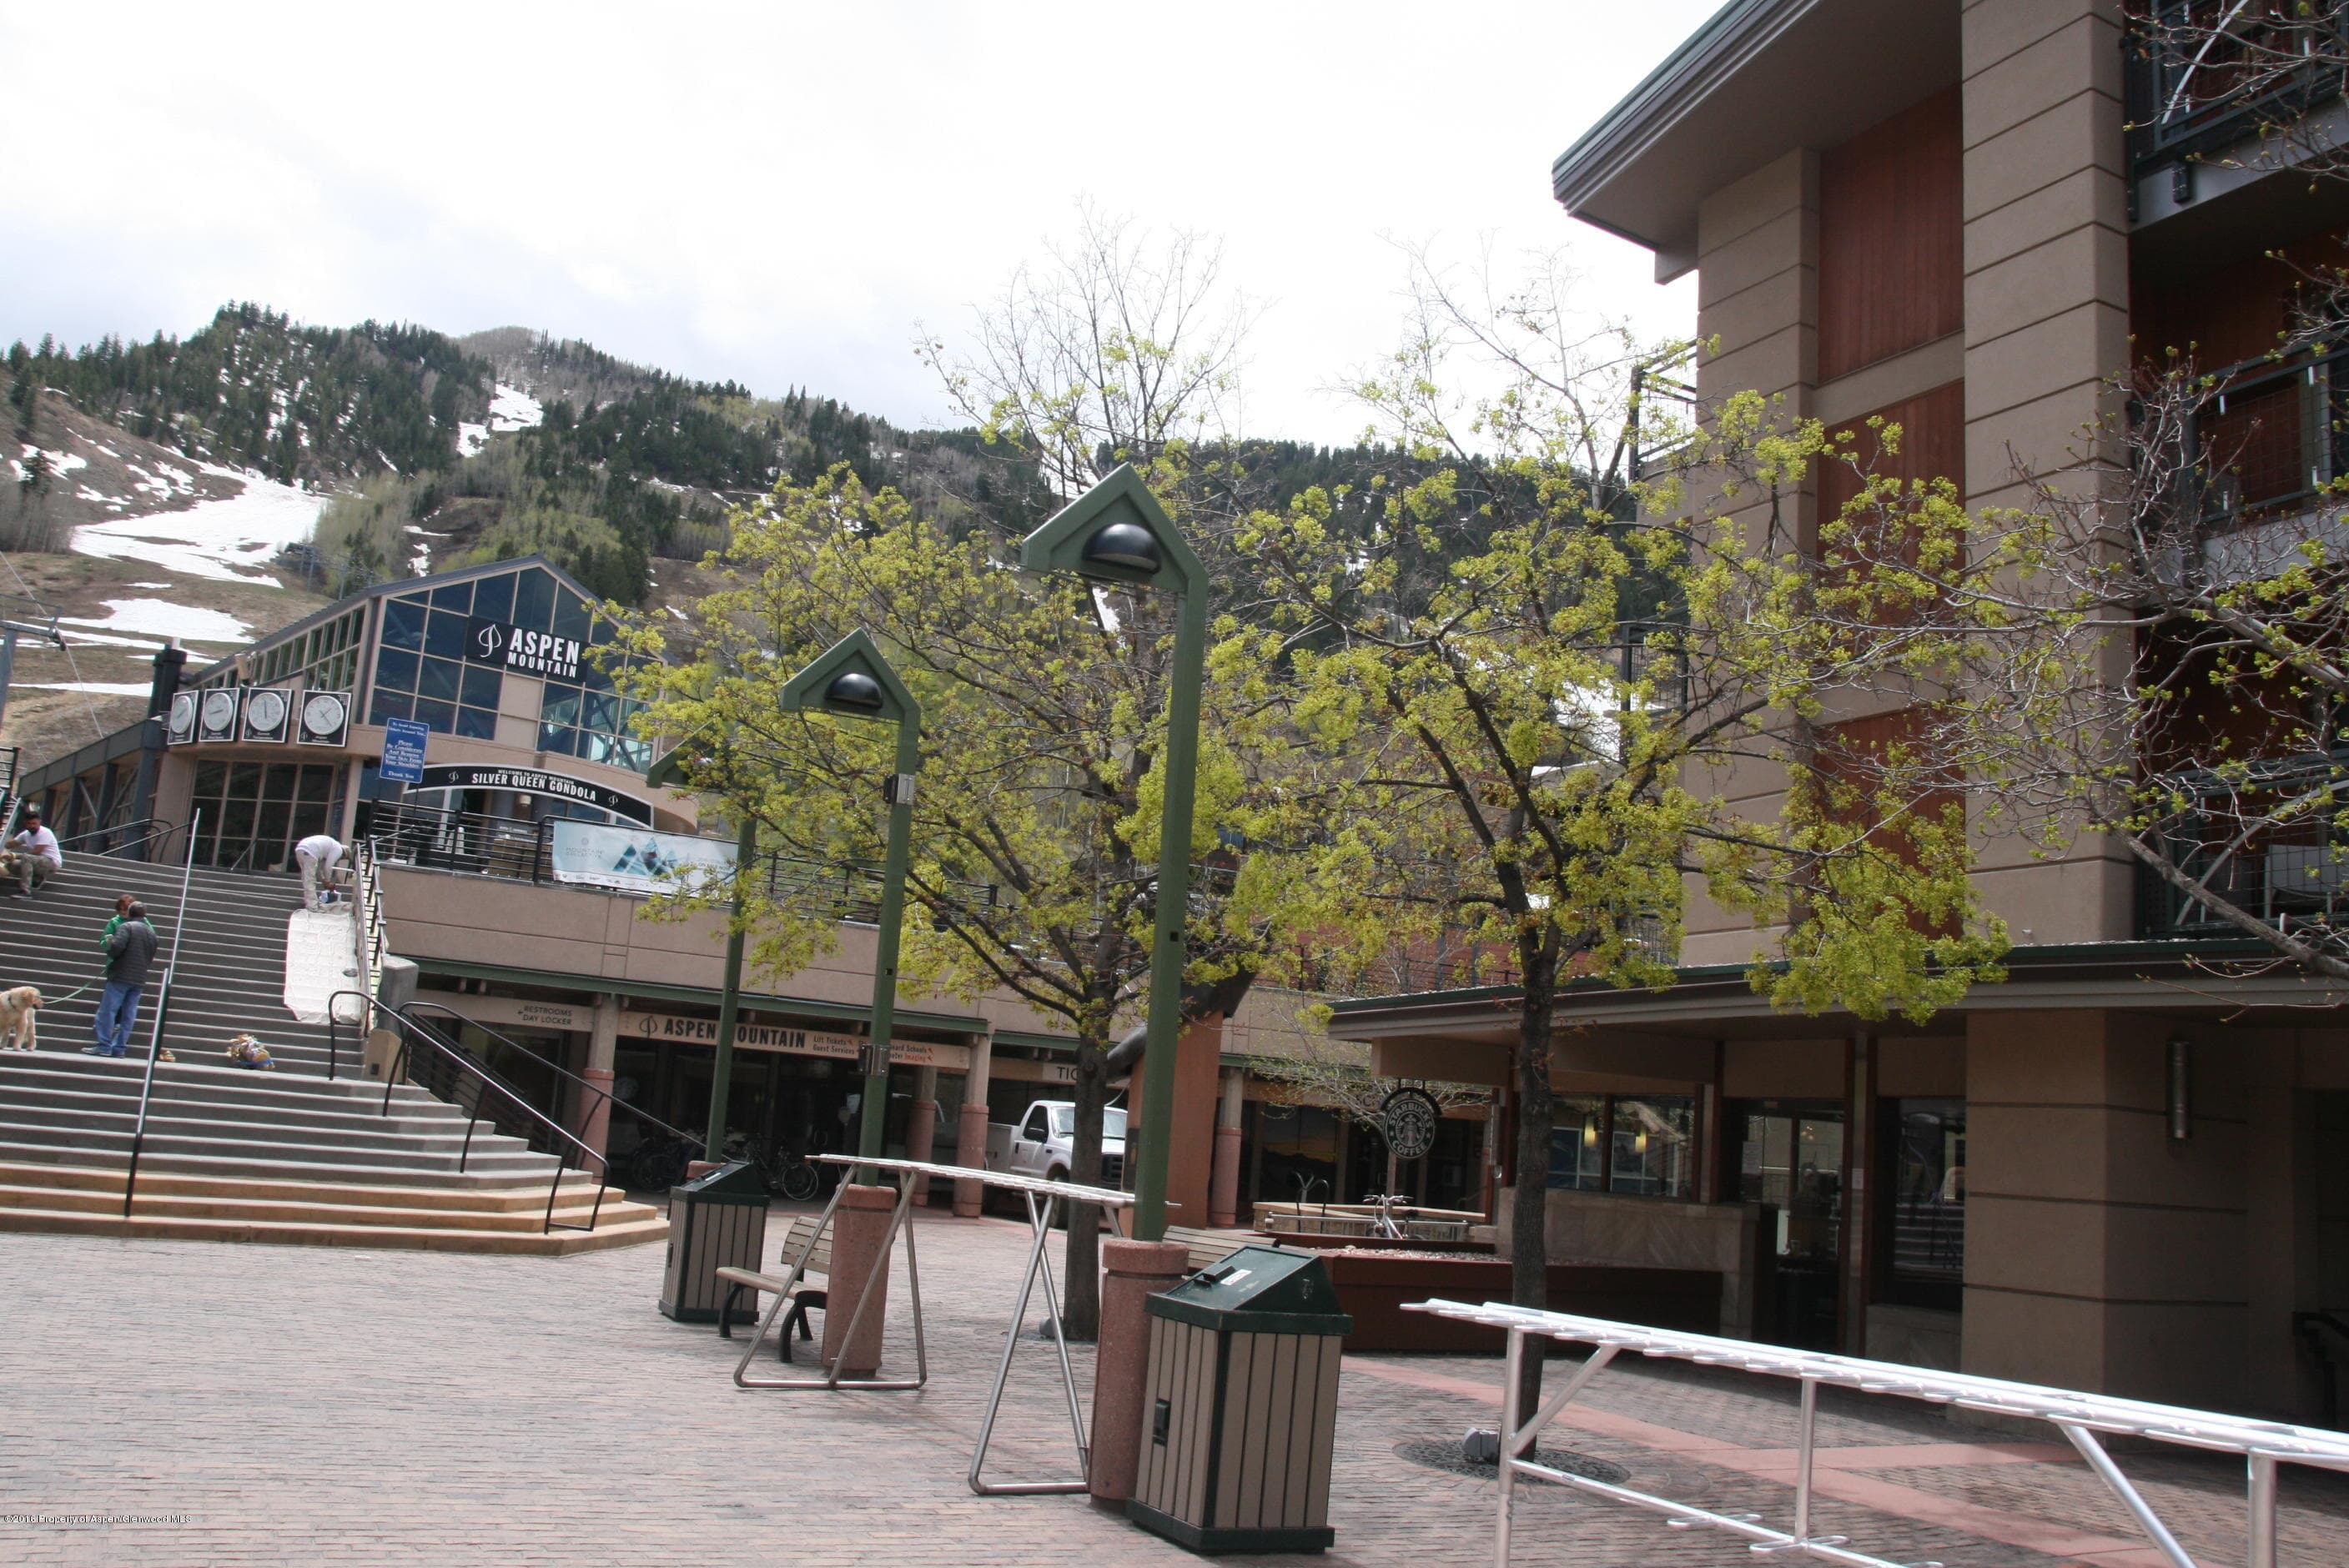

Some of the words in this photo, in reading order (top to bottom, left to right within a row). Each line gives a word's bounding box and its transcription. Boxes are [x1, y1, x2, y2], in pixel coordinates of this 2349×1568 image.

[510, 628, 580, 665] ASPEN
[507, 651, 577, 678] MOUNTAIN
[471, 773, 508, 785] SILVER
[511, 775, 546, 789] QUEEN
[549, 780, 596, 802] GONDOLA
[549, 776, 575, 785] MOUNTAIN
[524, 1006, 573, 1017] RESTROOMS
[541, 1016, 572, 1025] LOCKER
[664, 1018, 716, 1039] ASPEN
[737, 1026, 805, 1048] OUNTAIN
[813, 1035, 824, 1043] Lift
[827, 1036, 847, 1045] Tickets
[813, 1043, 829, 1052] Guest
[831, 1046, 855, 1055] Services
[1057, 1066, 1079, 1081] TIC
[1388, 1103, 1433, 1128] STARBUCKS
[1392, 1139, 1427, 1156] COFFEE
